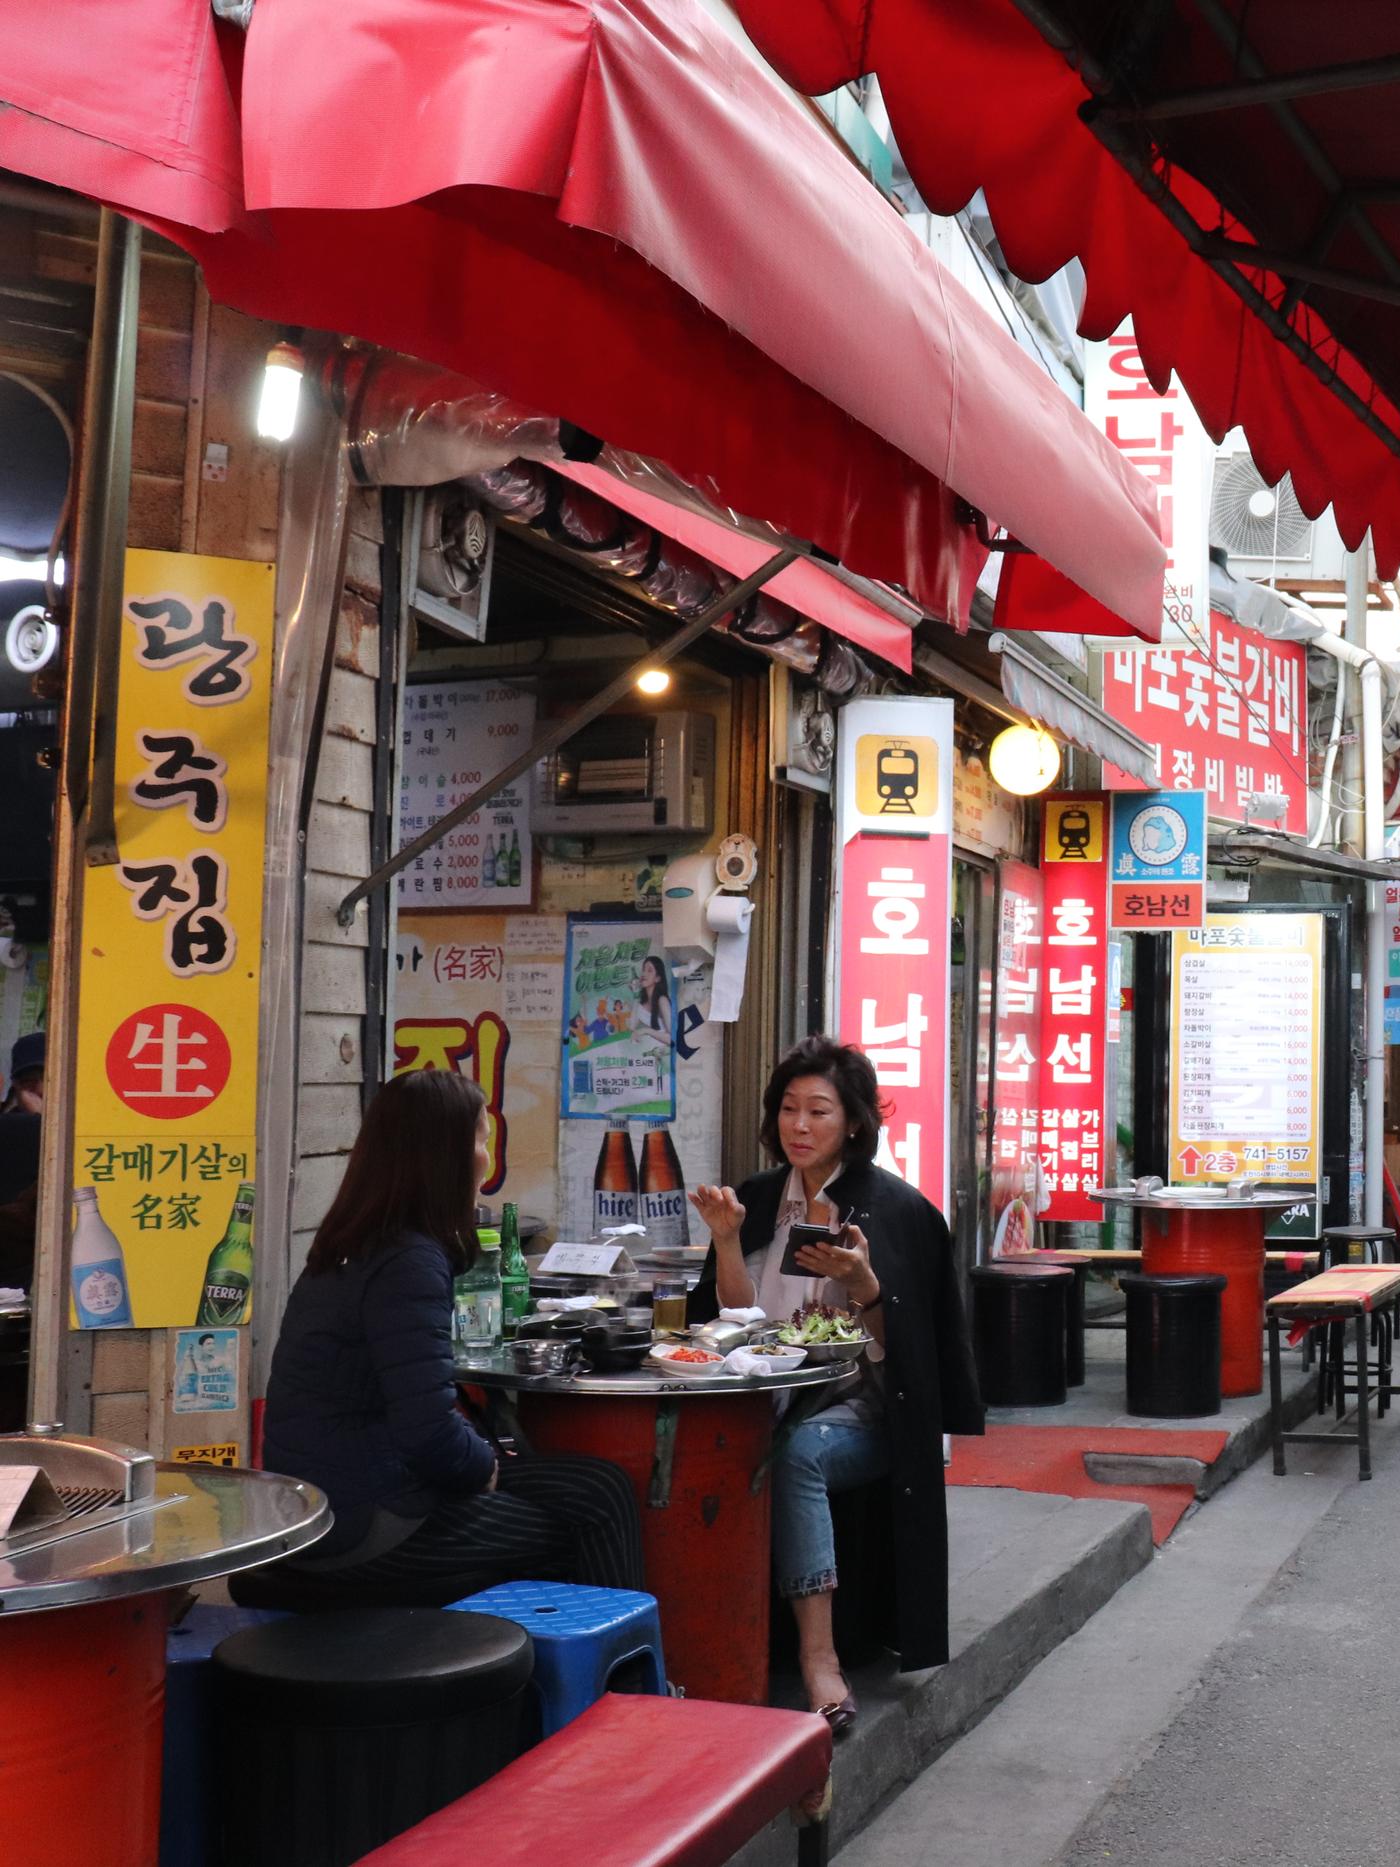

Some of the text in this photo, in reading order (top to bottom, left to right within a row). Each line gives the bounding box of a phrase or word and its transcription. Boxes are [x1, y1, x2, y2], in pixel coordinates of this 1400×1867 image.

[1113, 631, 1299, 756] 마포숯불갈비
[123, 600, 248, 969] 광주집
[447, 855, 478, 869] 2,000
[1123, 894, 1191, 917] 호남선
[1046, 898, 1097, 1083] 호남선
[122, 1013, 215, 1098] 生
[84, 1143, 248, 1182] 갈매기살의
[1081, 1108, 1100, 1191] 가브리살
[1205, 1152, 1236, 1172] 2층
[131, 1193, 202, 1230] 名家
[599, 1192, 634, 1217] hite
[646, 1195, 683, 1218] hite
[207, 1285, 245, 1301] TERRA
[176, 1447, 236, 1460] 무지개
